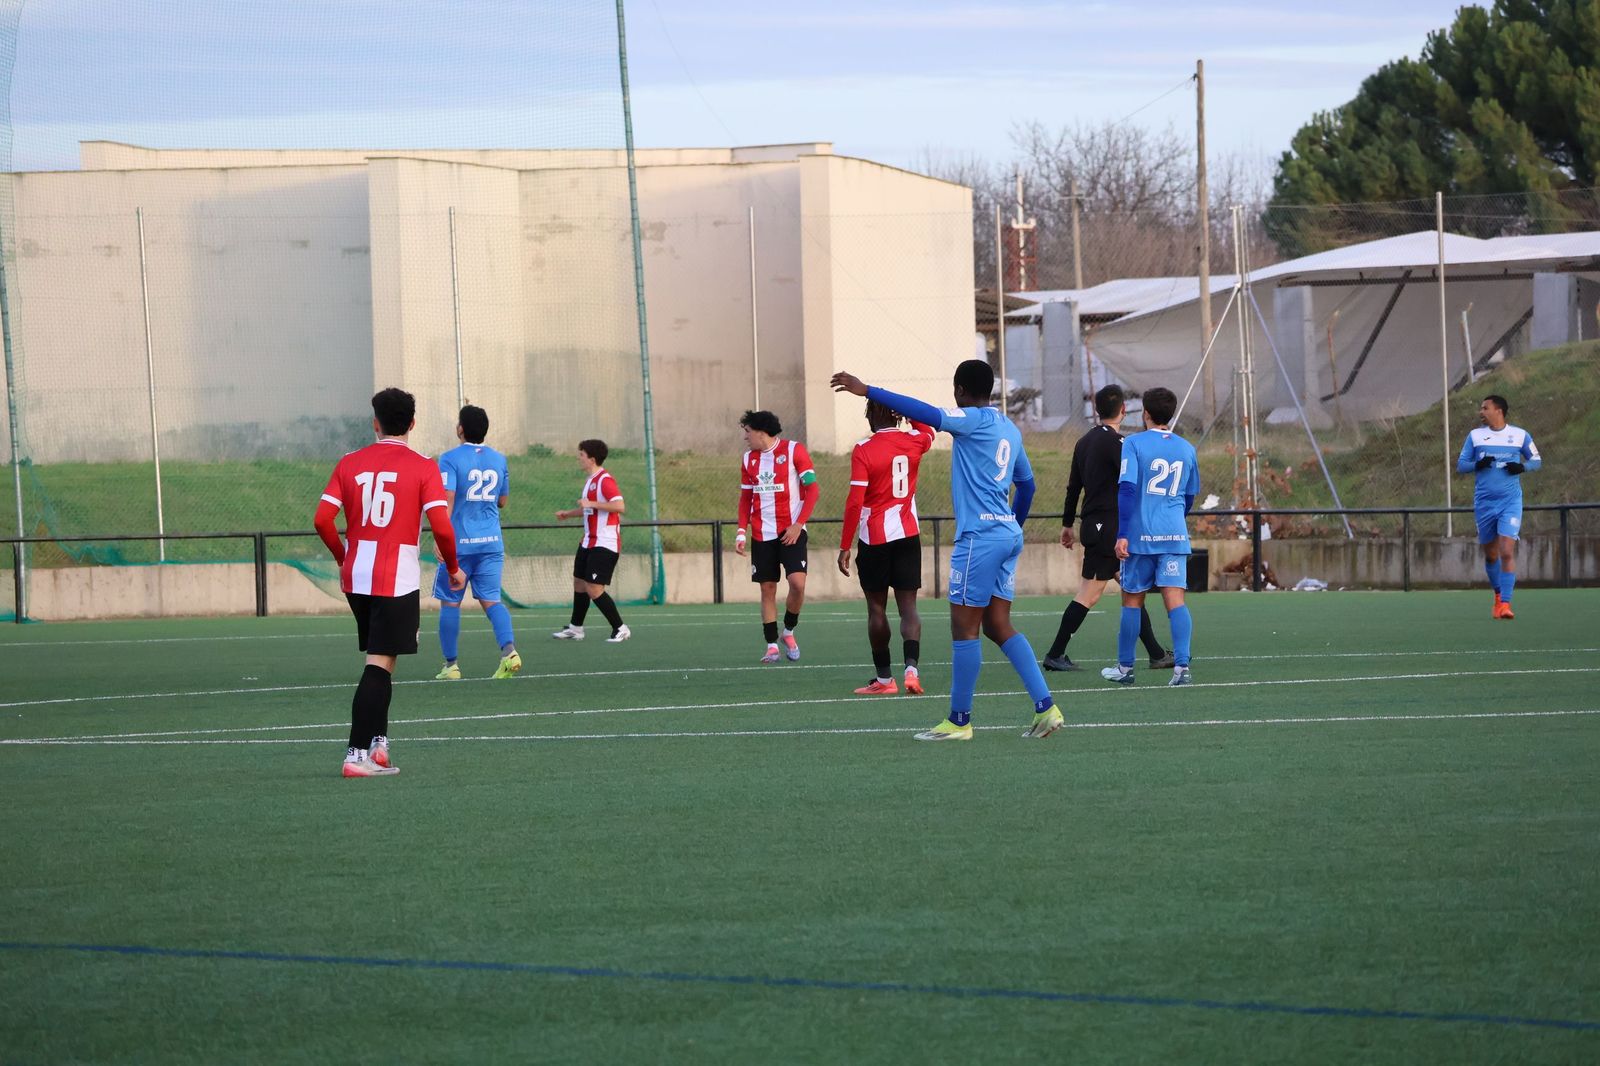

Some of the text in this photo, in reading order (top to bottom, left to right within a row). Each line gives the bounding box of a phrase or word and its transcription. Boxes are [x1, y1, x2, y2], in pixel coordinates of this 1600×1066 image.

[892, 455, 909, 498] 8
[994, 438, 1011, 481] 9
[1146, 458, 1183, 497] 21
[354, 471, 398, 528] 16
[466, 469, 498, 502] 22
